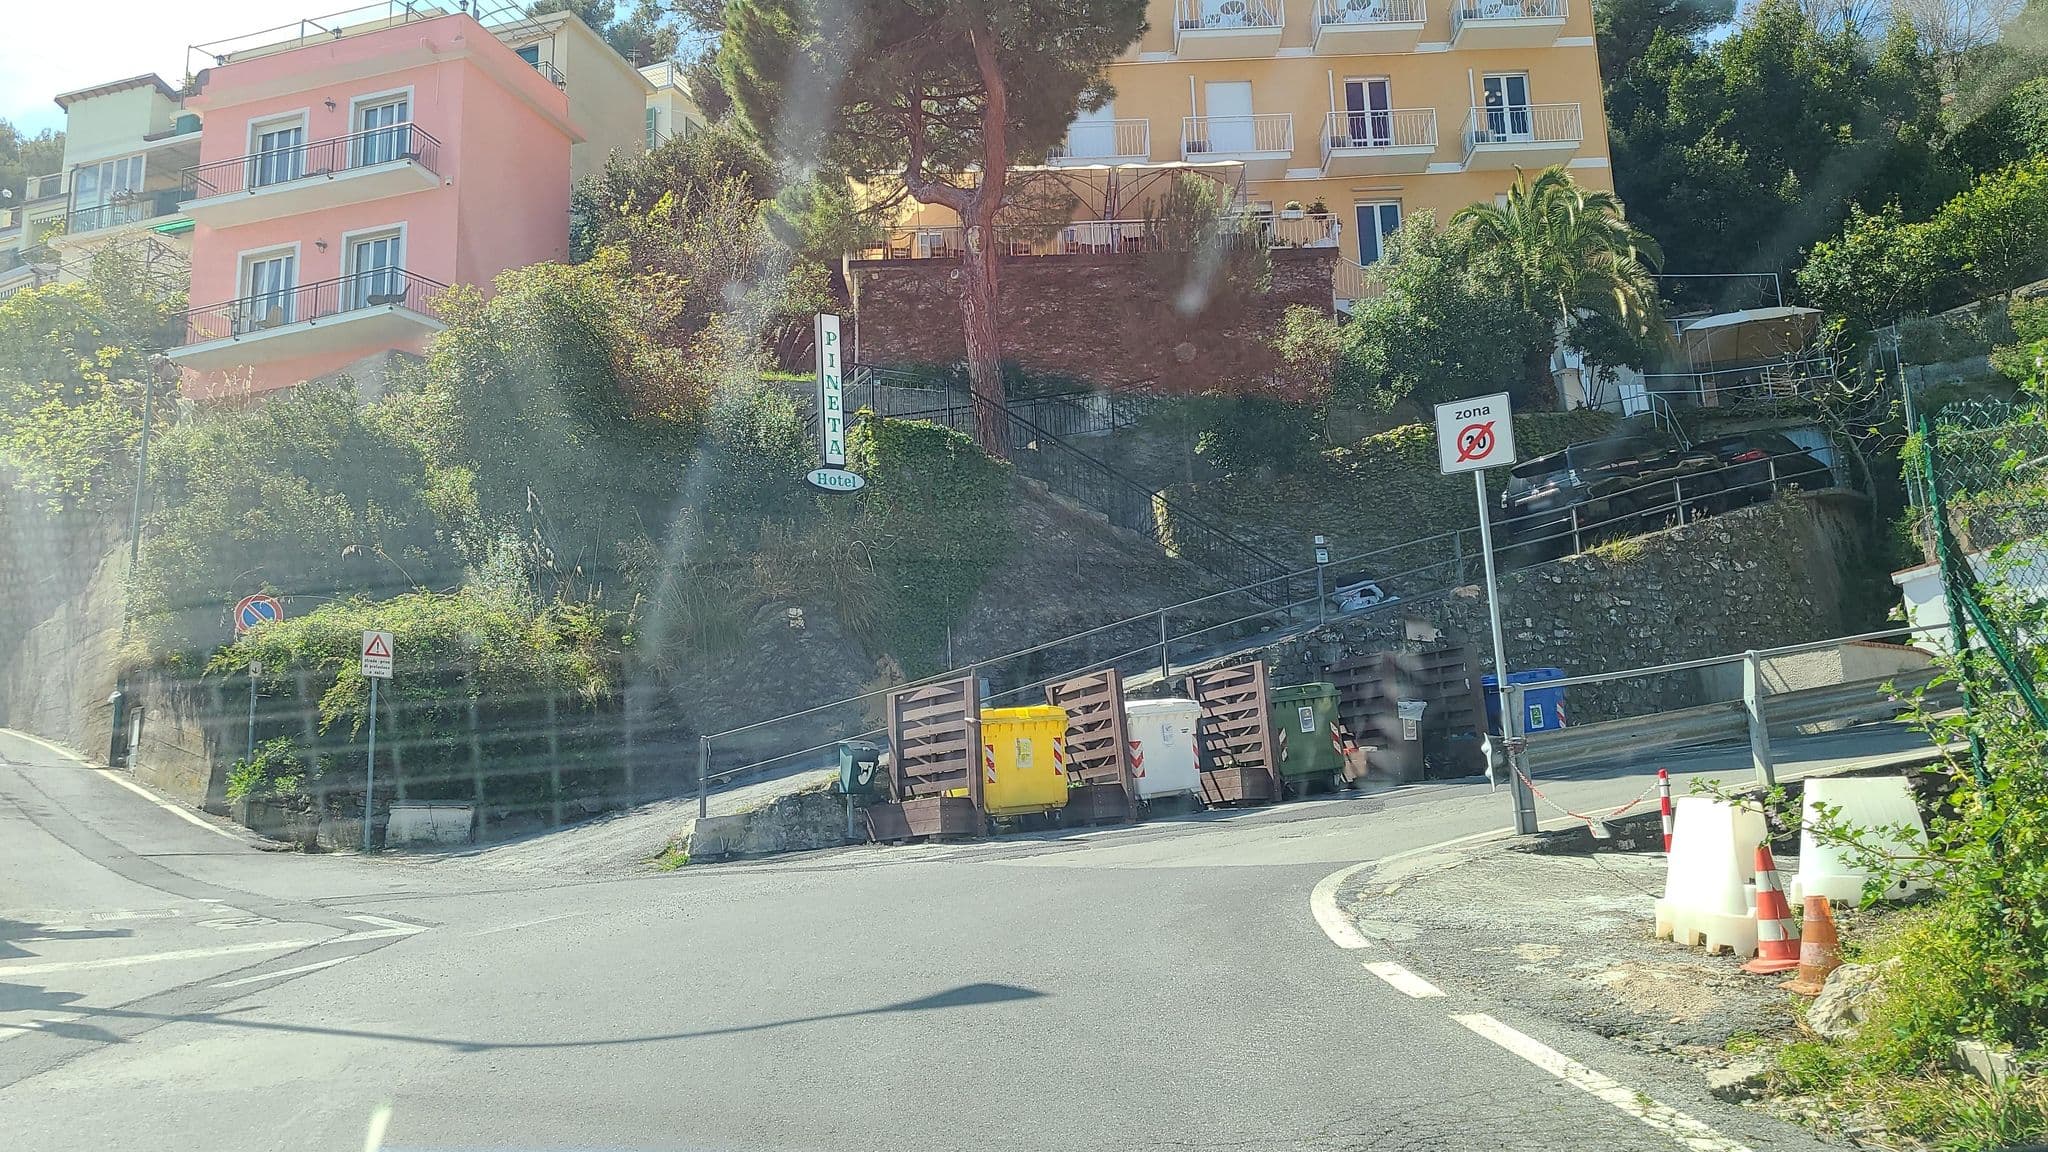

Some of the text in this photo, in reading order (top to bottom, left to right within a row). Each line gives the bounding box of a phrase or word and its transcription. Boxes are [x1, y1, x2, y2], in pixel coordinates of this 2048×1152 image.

[825, 331, 842, 456] PINETA
[1455, 406, 1490, 420] zona
[816, 472, 857, 488] Hotel
